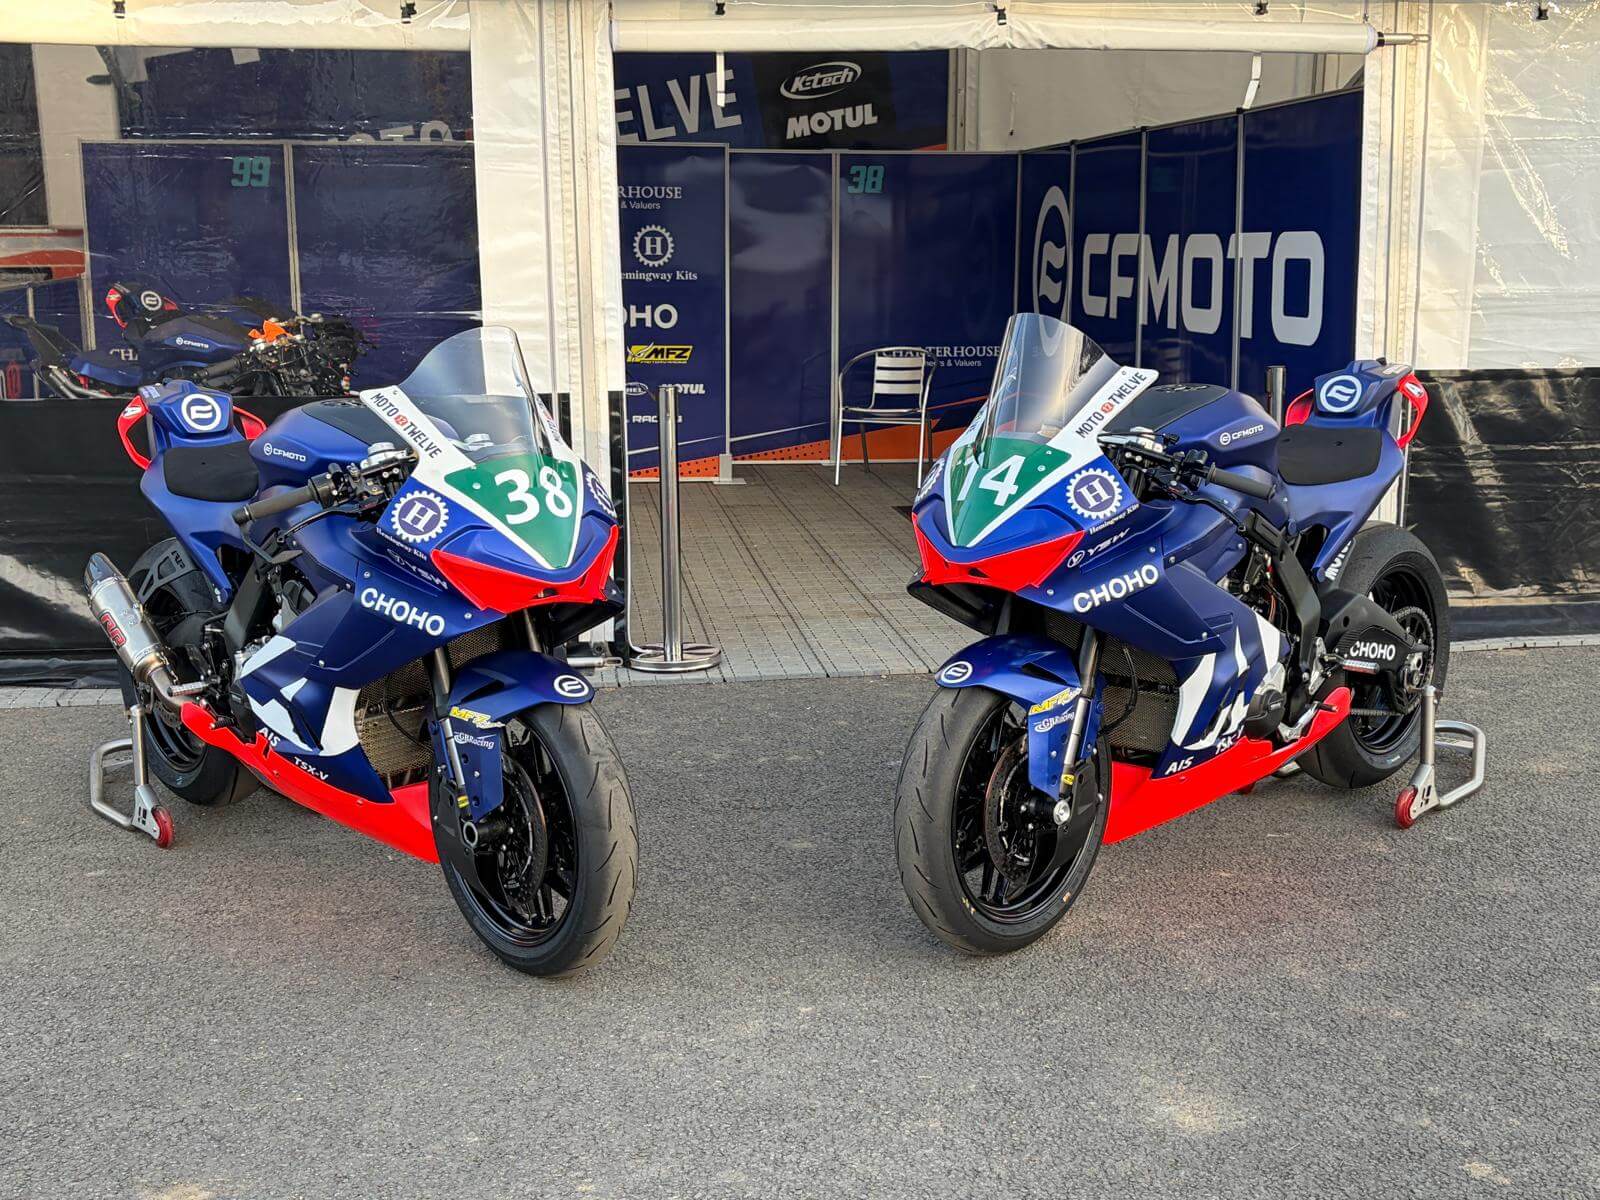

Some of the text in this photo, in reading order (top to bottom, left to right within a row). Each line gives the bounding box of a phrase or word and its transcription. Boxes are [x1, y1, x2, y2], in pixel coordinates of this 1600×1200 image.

[786, 103, 878, 140] MOTUL
[231, 156, 271, 187] 99
[848, 165, 885, 194] 38
[629, 201, 661, 210] Valuers
[676, 270, 698, 280] Kits
[1082, 231, 1325, 347] CFMOTO
[645, 347, 691, 359] MFZ
[954, 359, 982, 367] Valuers
[1075, 411, 1104, 439] MOTO
[1108, 371, 1147, 407] TWELVE
[370, 392, 399, 417] MOTO
[403, 421, 442, 459] TWELVE
[1231, 424, 1264, 440] CFMOTO
[272, 447, 306, 462] CFMOTO
[493, 466, 573, 526] 38
[1072, 564, 1160, 614] CHOHO
[360, 588, 446, 637] CHOHO
[1349, 640, 1396, 661] CHOHO
[258, 727, 281, 747] AIS
[293, 756, 329, 781] TSX-V
[1164, 756, 1195, 775] AIS
